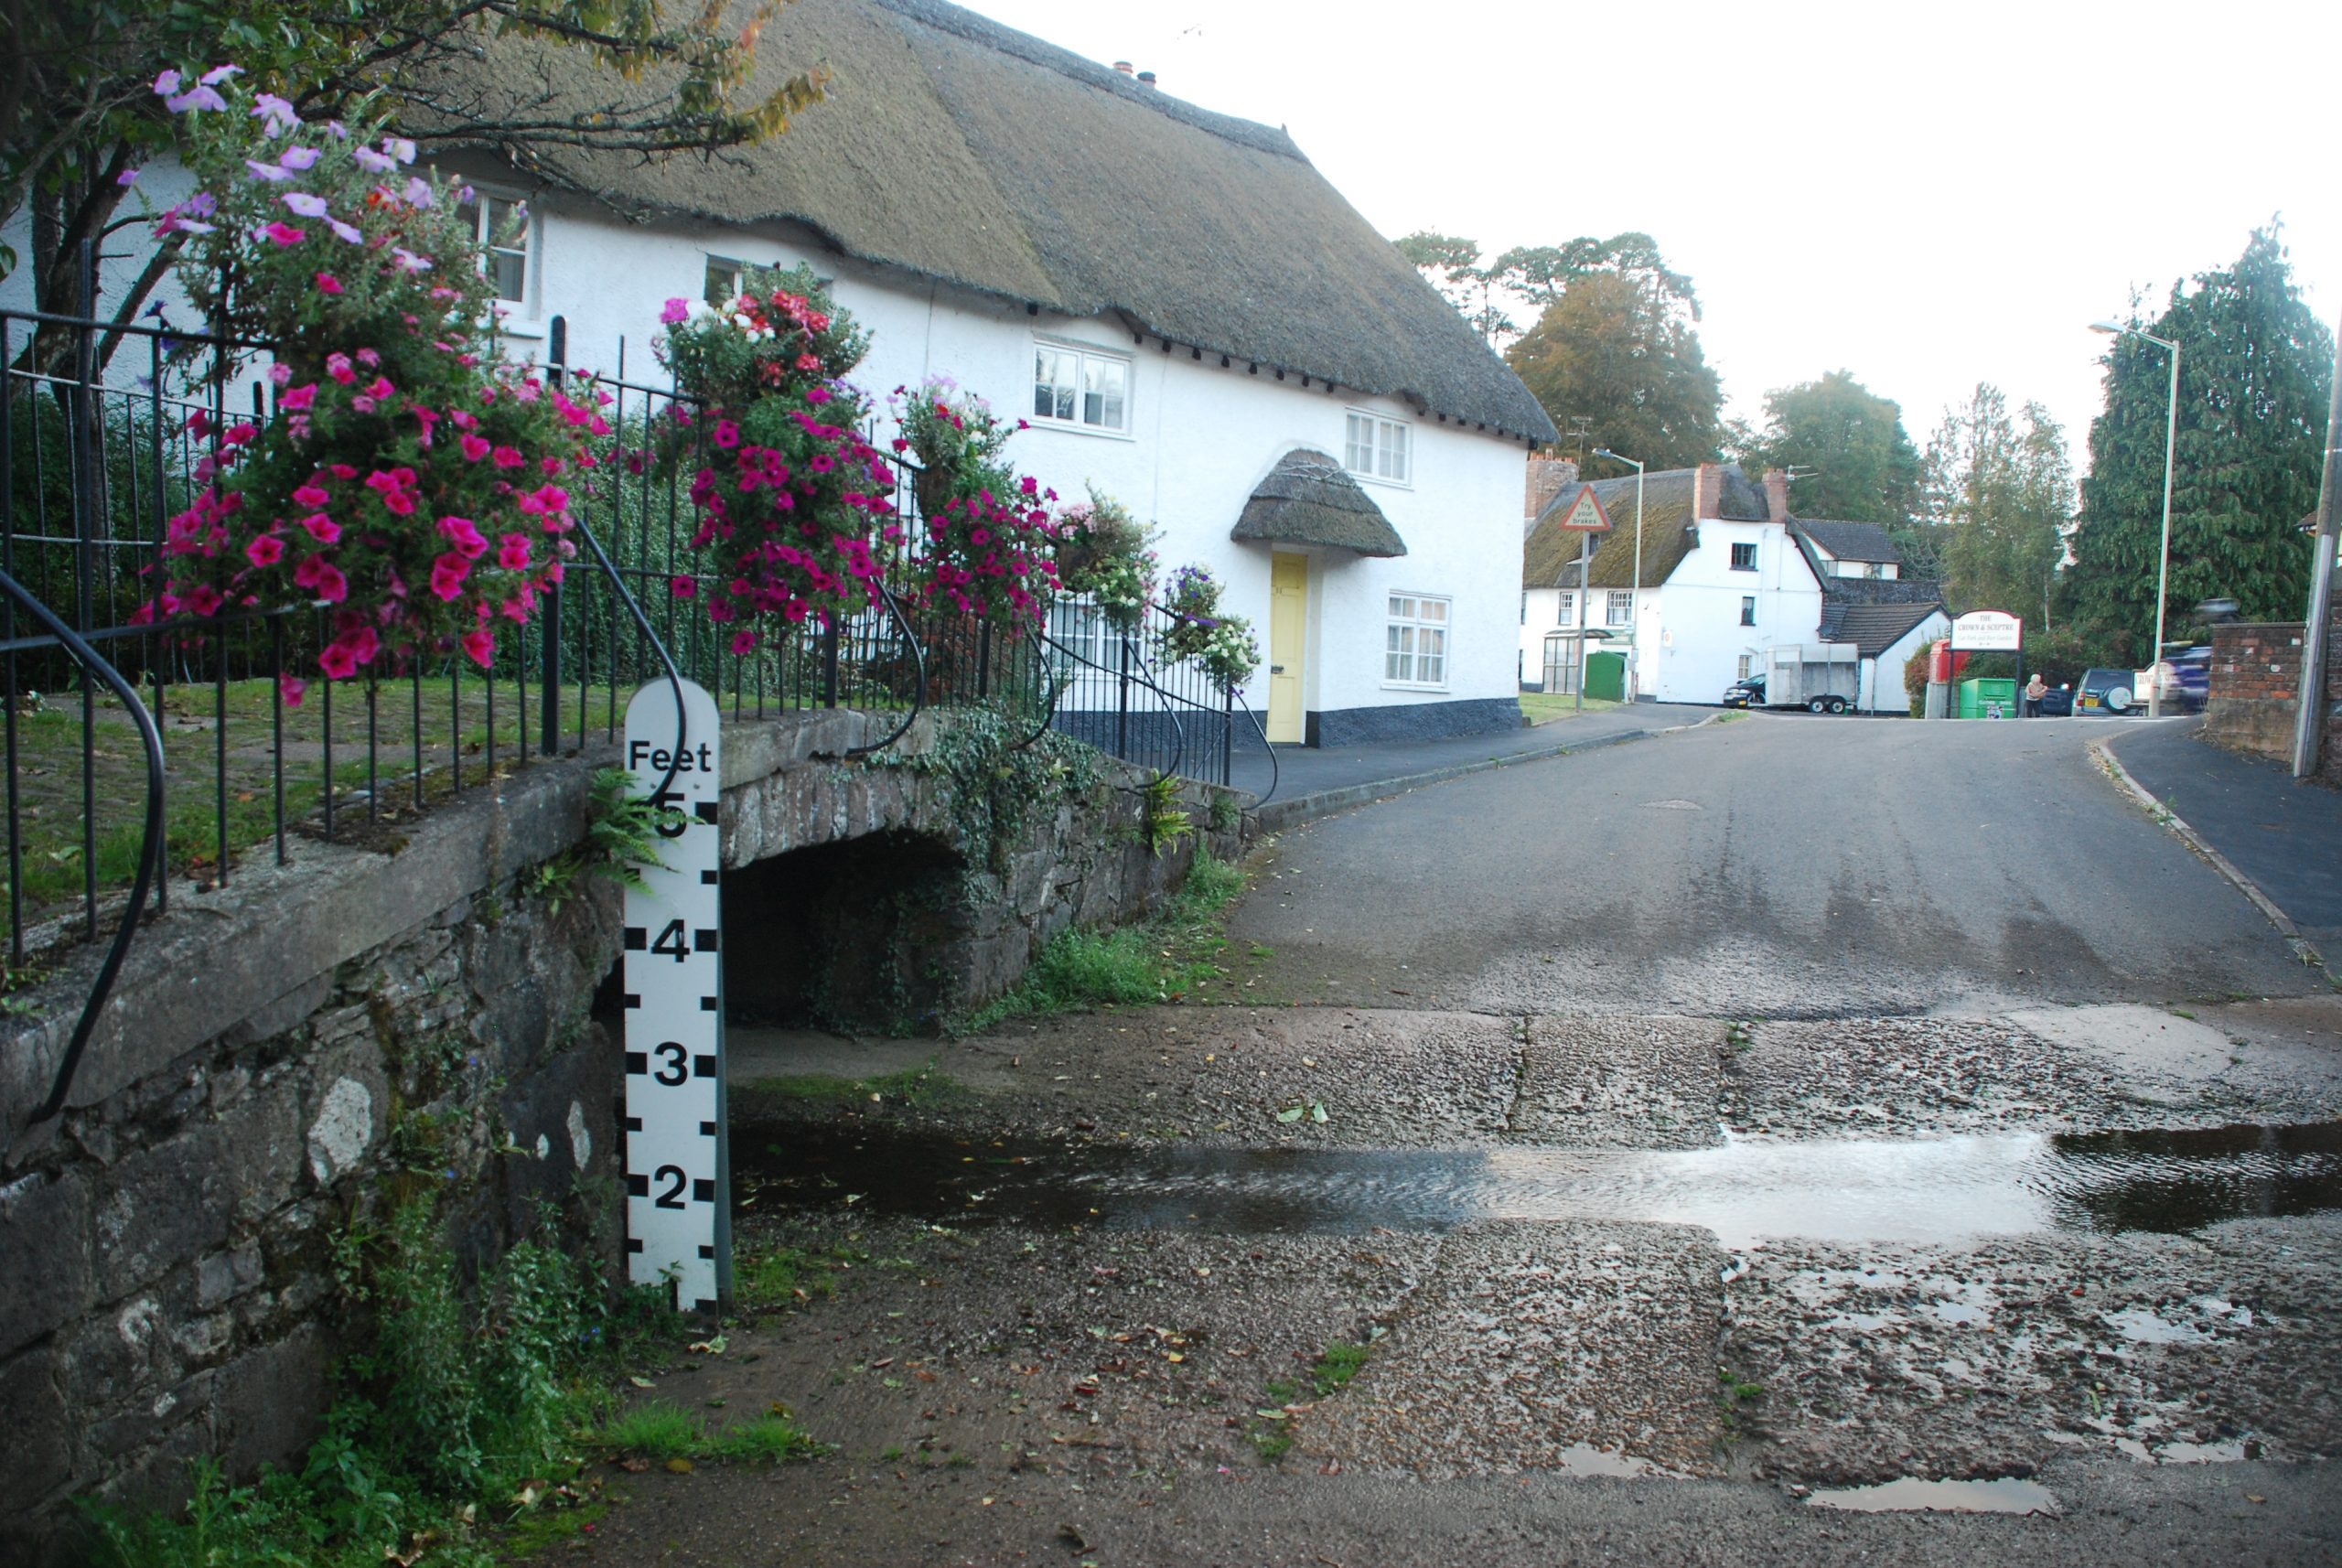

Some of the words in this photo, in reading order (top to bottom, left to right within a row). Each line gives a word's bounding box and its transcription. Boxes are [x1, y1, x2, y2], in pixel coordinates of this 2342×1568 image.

[629, 740, 712, 772] Feet
[655, 792, 687, 838] 5
[650, 918, 690, 962] 4
[654, 1041, 688, 1087] 3
[654, 1164, 687, 1210] 2
